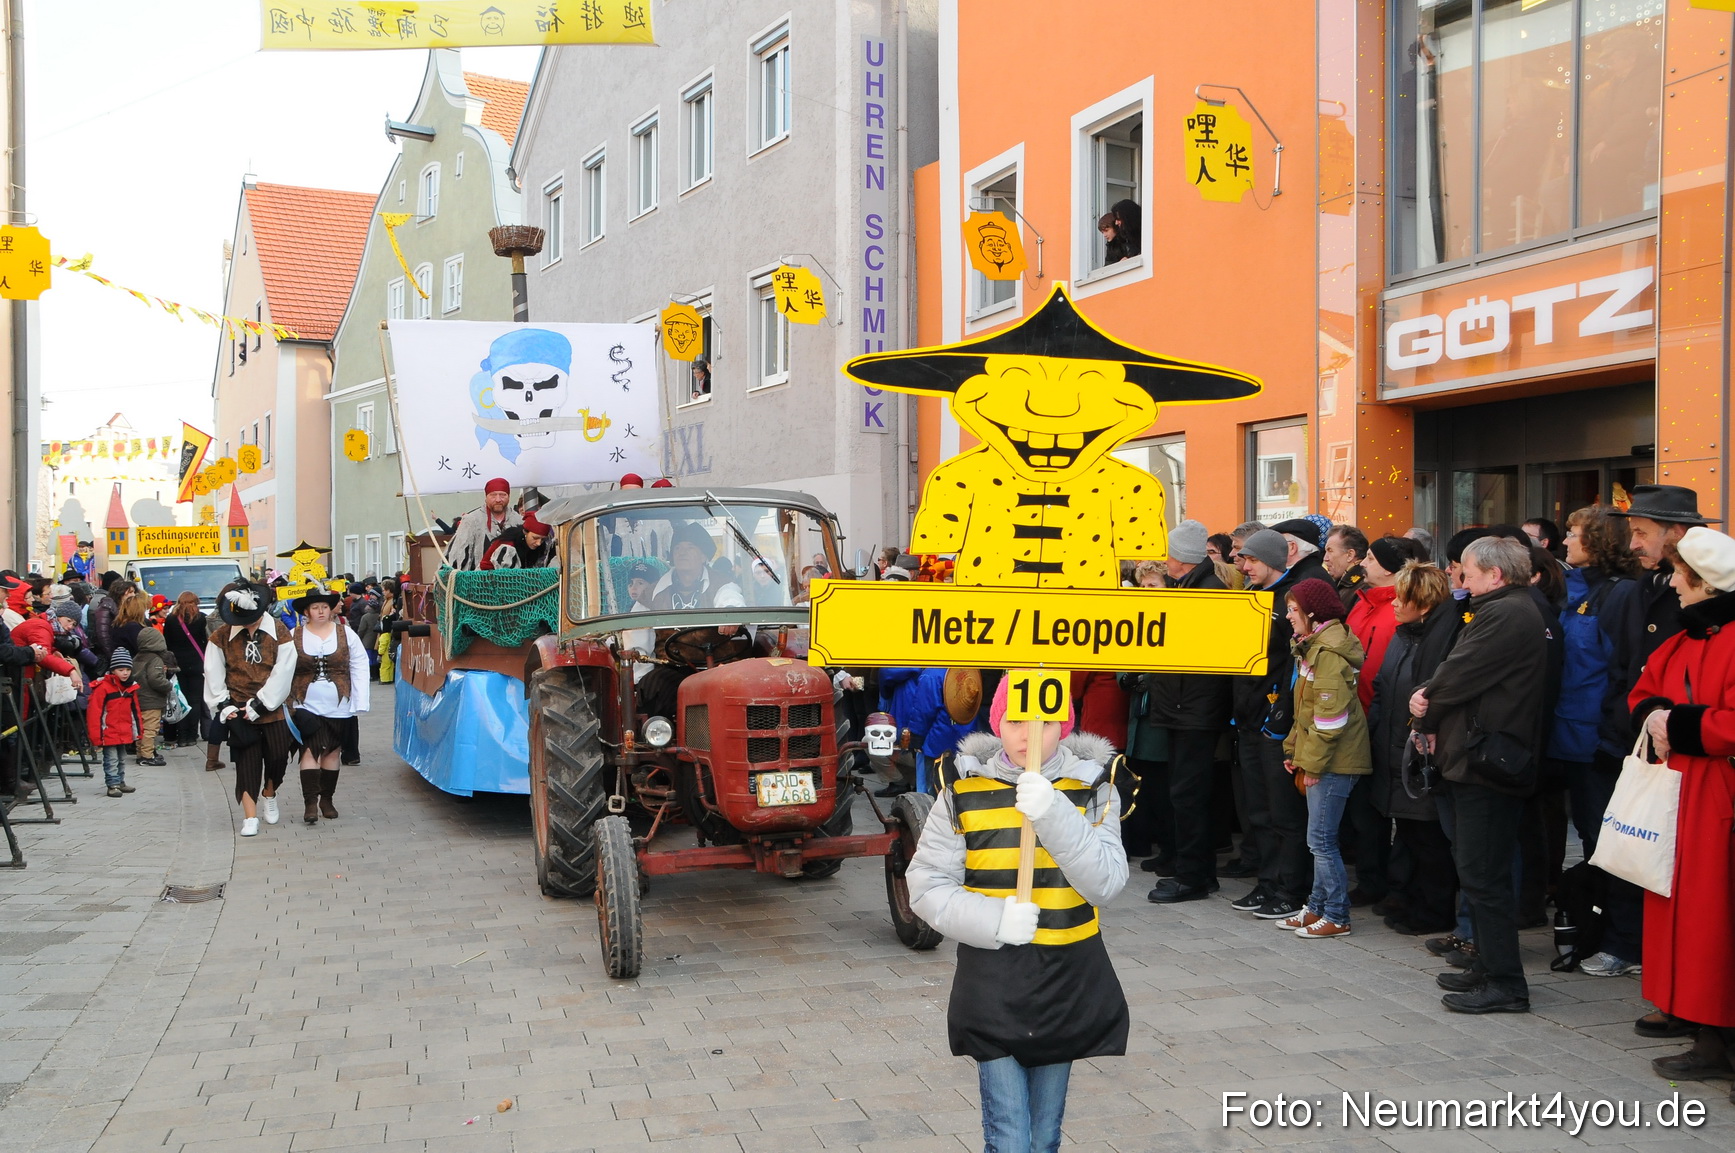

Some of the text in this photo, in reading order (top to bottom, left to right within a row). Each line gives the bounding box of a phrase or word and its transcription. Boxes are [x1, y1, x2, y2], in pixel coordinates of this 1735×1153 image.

[865, 40, 885, 191] UHREN
[1225, 143, 1250, 177] 华
[1195, 156, 1217, 185] 人
[784, 296, 800, 314] 人
[803, 289, 824, 310] 华
[1386, 265, 1654, 371] GÖTZ
[624, 422, 639, 439] 火
[438, 454, 453, 471] 火
[609, 446, 627, 463] 水
[461, 461, 481, 479] 水
[136, 528, 219, 542] Faschingsverein
[911, 608, 1167, 655] Metz / Leopold
[1012, 677, 1064, 715] 10
[774, 774, 799, 788] RID
[781, 789, 811, 804] 468
